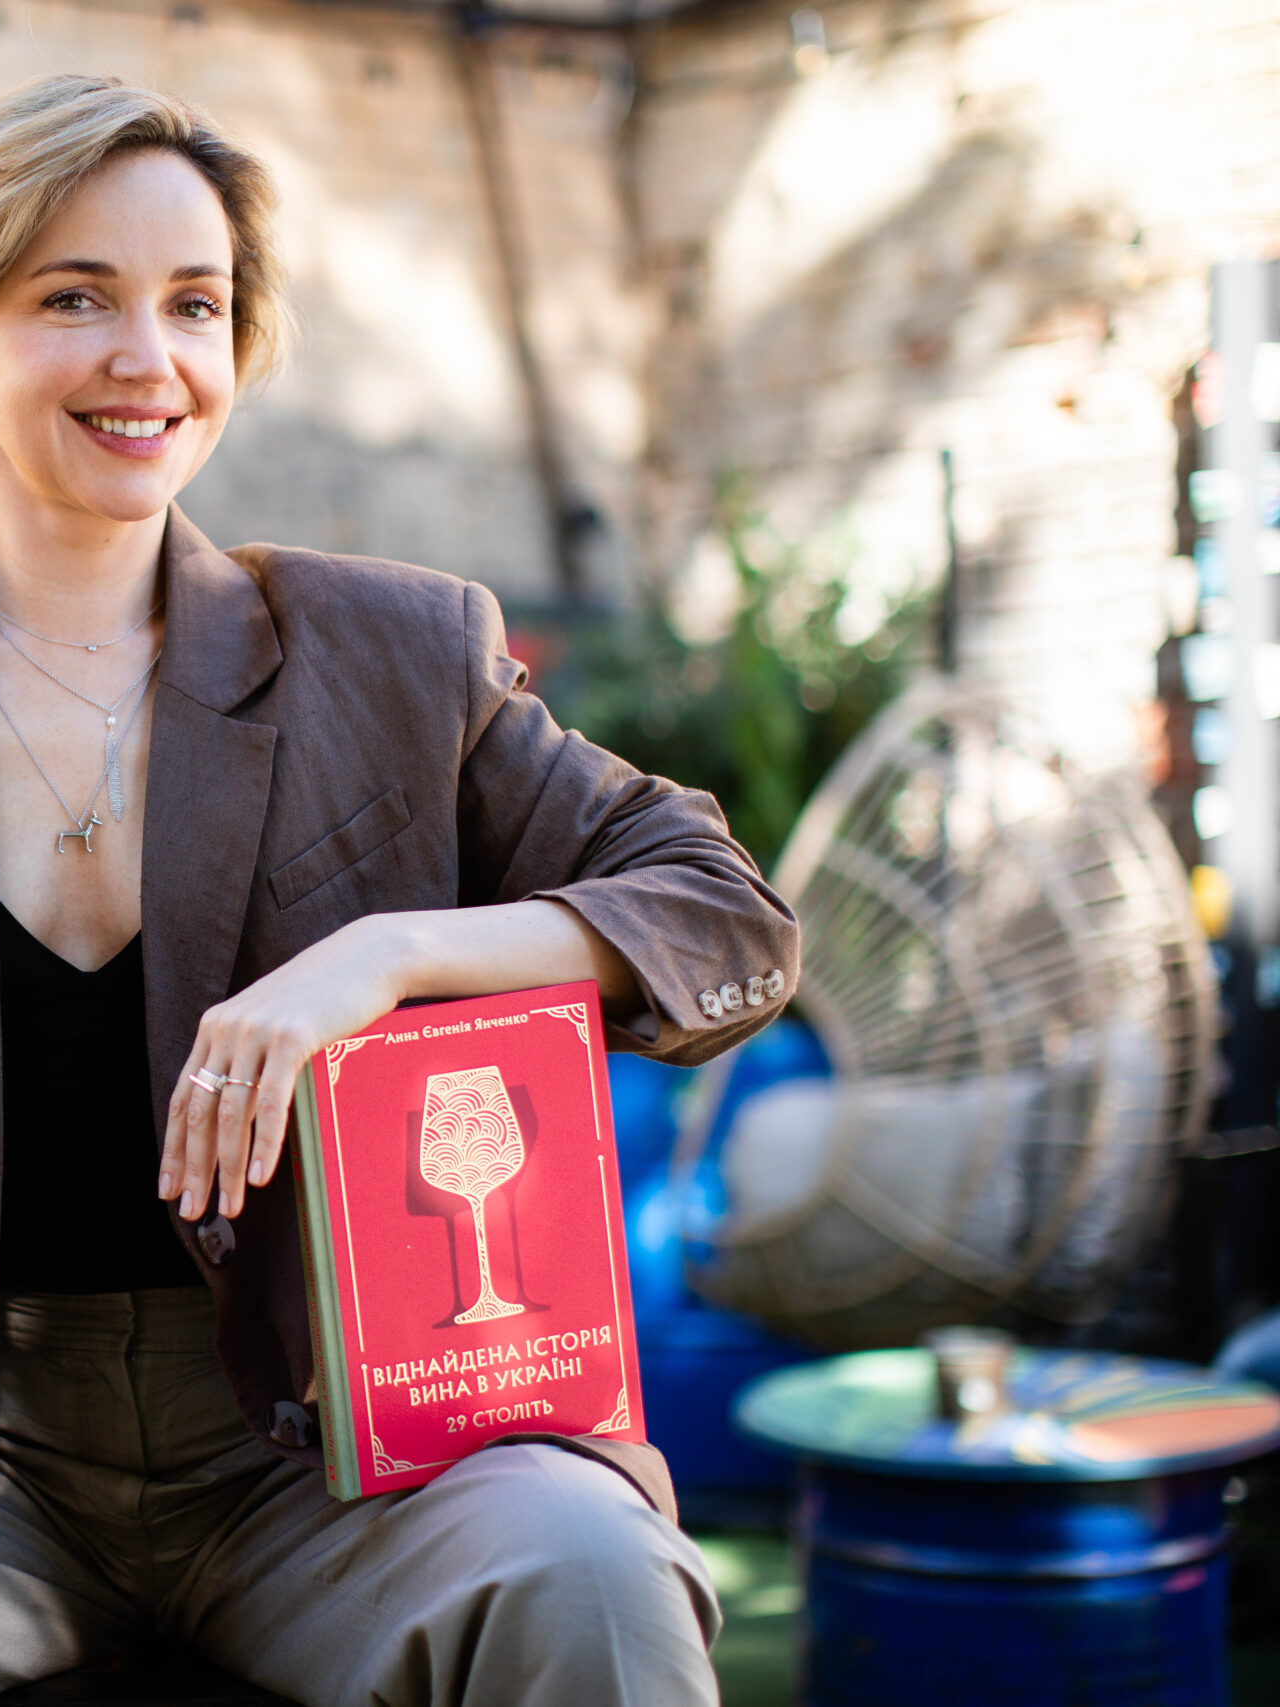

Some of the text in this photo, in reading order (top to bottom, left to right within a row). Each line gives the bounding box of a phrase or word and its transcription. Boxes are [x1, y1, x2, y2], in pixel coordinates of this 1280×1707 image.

[384, 1013, 529, 1045] Анна Євгенія Янченко
[372, 1325, 612, 1387] ВІДНАЙДЕНА ІСТОРІЯ
[409, 1357, 583, 1406] ВИНА В УКРАЇНІ
[446, 1399, 554, 1433] 29 СТОЛІТЬ
